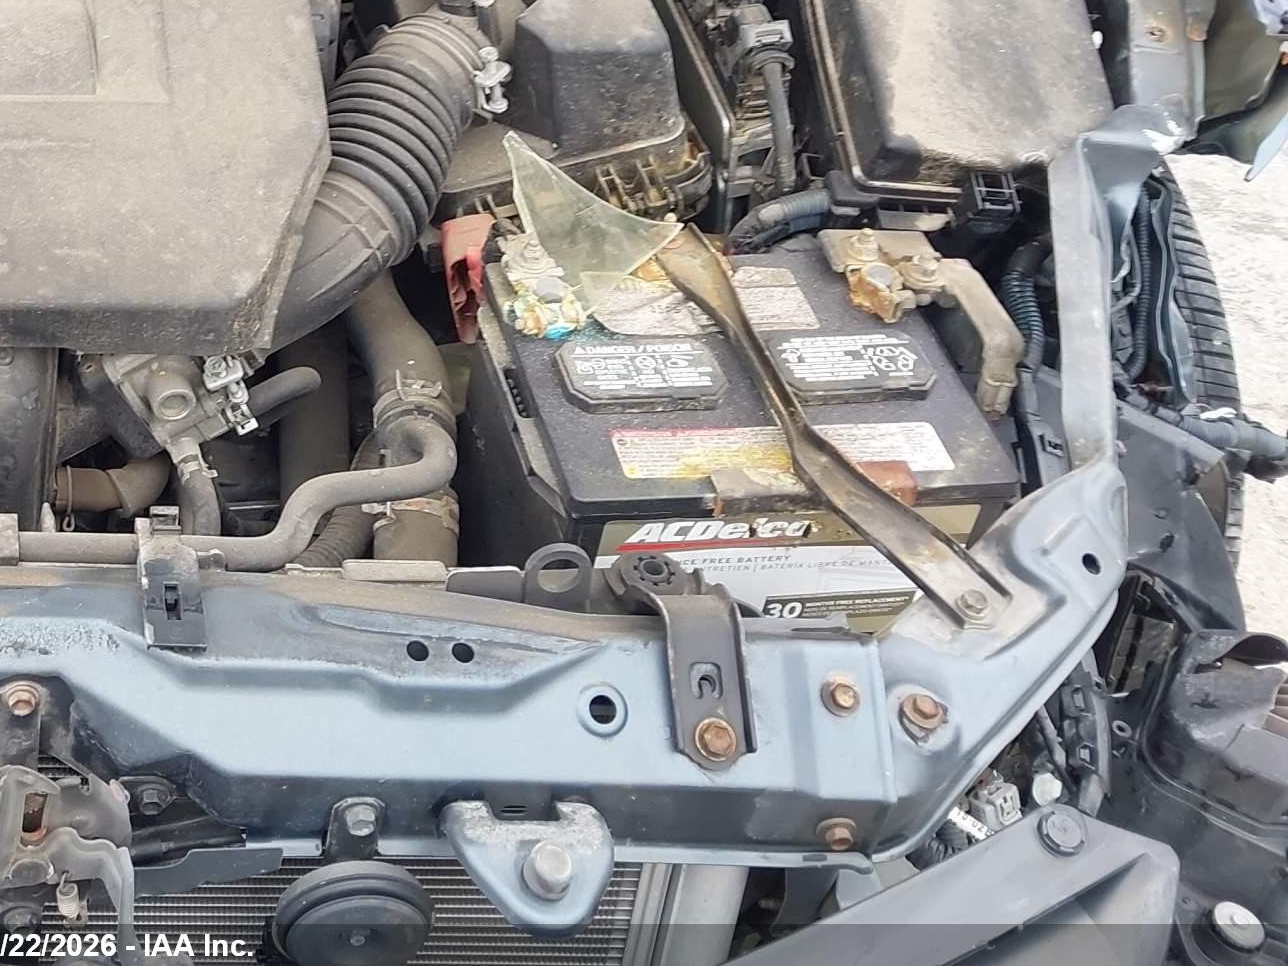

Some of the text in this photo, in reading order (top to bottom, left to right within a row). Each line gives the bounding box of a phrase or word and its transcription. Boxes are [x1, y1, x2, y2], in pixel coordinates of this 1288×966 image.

[625, 518, 812, 543] ACDelco
[702, 557, 733, 565] FREE
[737, 555, 791, 563] BATTERY
[764, 602, 803, 618] 30
